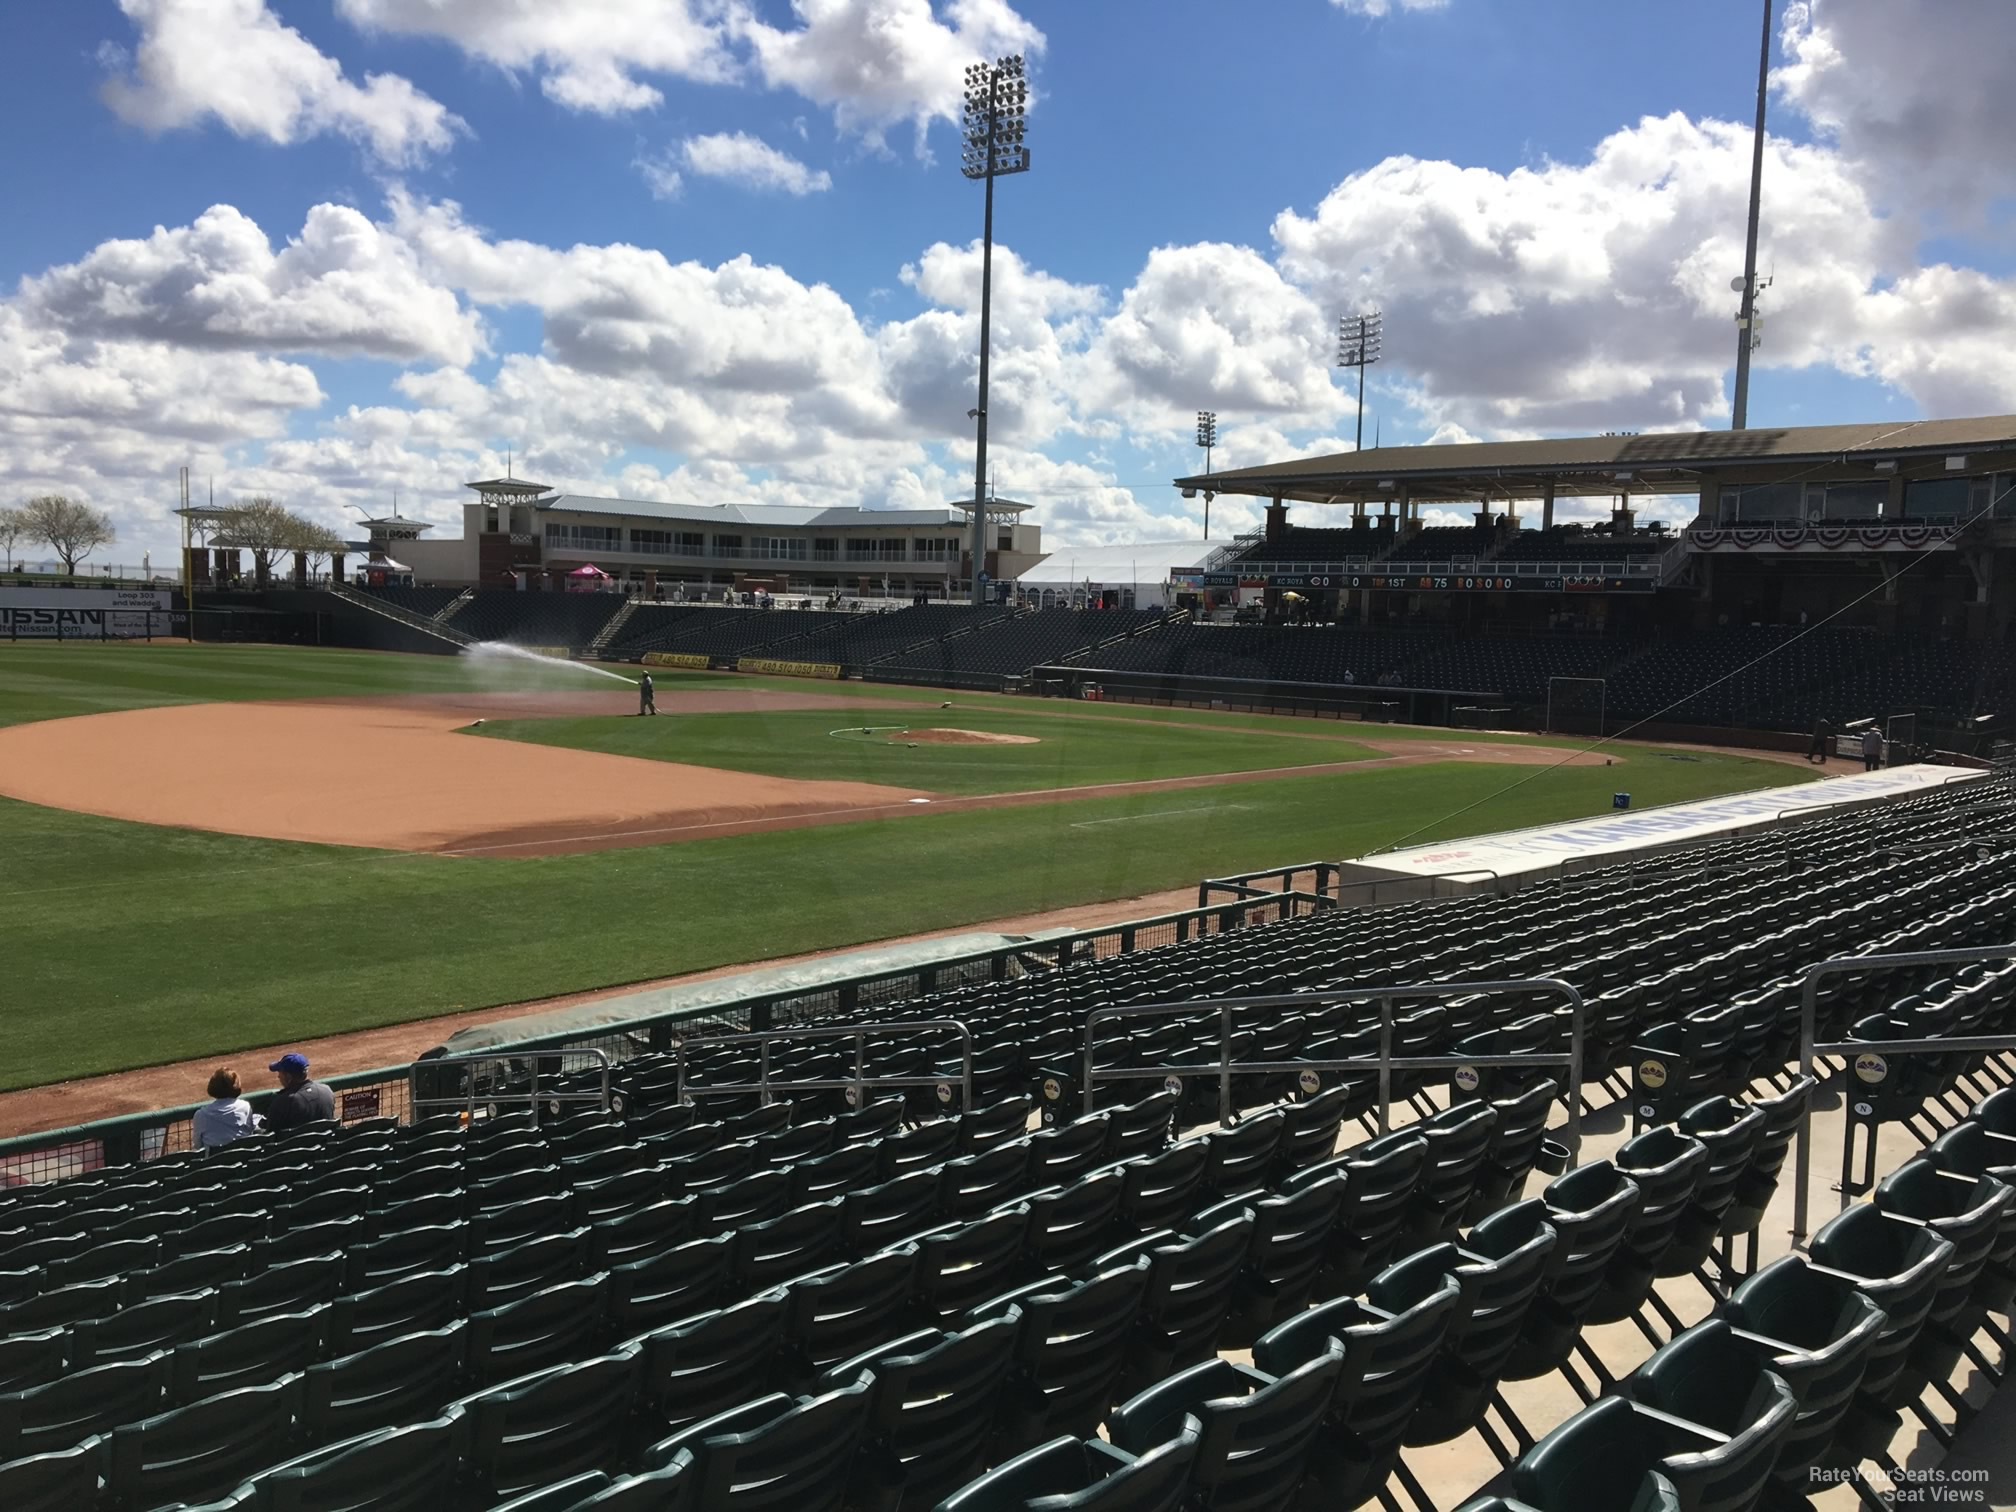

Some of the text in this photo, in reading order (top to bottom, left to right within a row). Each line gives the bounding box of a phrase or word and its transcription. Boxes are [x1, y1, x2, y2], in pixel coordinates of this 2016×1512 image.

[1322, 576, 1330, 587] 0
[1352, 577, 1360, 587] 0
[1371, 577, 1385, 588] TOP
[1388, 577, 1406, 588] 1ST
[1434, 577, 1448, 588] 75
[1465, 577, 1473, 588] 0
[1485, 577, 1493, 588] 0
[1504, 577, 1512, 588] 0
[762, 662, 812, 675] 480.510.1050
[1535, 779, 1906, 847] KANSAS CITY ROYALS
[345, 1092, 371, 1101] CAUTION
